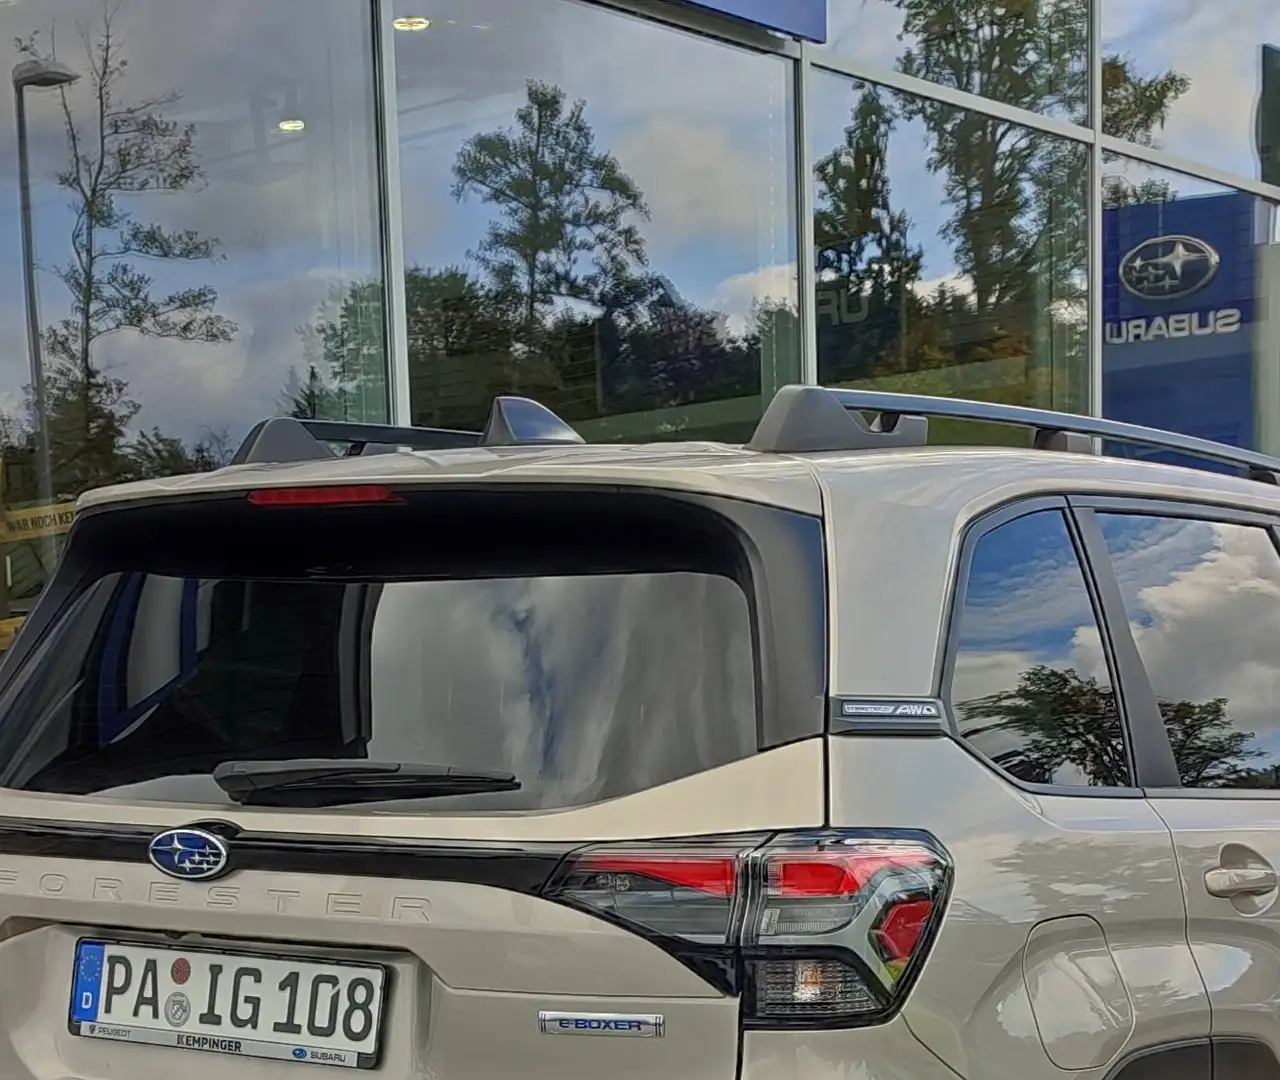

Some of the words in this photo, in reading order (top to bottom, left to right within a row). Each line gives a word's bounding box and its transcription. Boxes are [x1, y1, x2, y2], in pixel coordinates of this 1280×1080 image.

[895, 704, 936, 715] AWD
[81, 991, 93, 1009] D
[105, 954, 160, 1020] PA
[198, 963, 263, 1030] IG
[272, 970, 375, 1042] 108
[558, 1018, 642, 1032] e-BOXER
[98, 1026, 132, 1039] PEUGEOT
[176, 1034, 243, 1053] KEMPINGER
[310, 1050, 347, 1063] SUBARU
